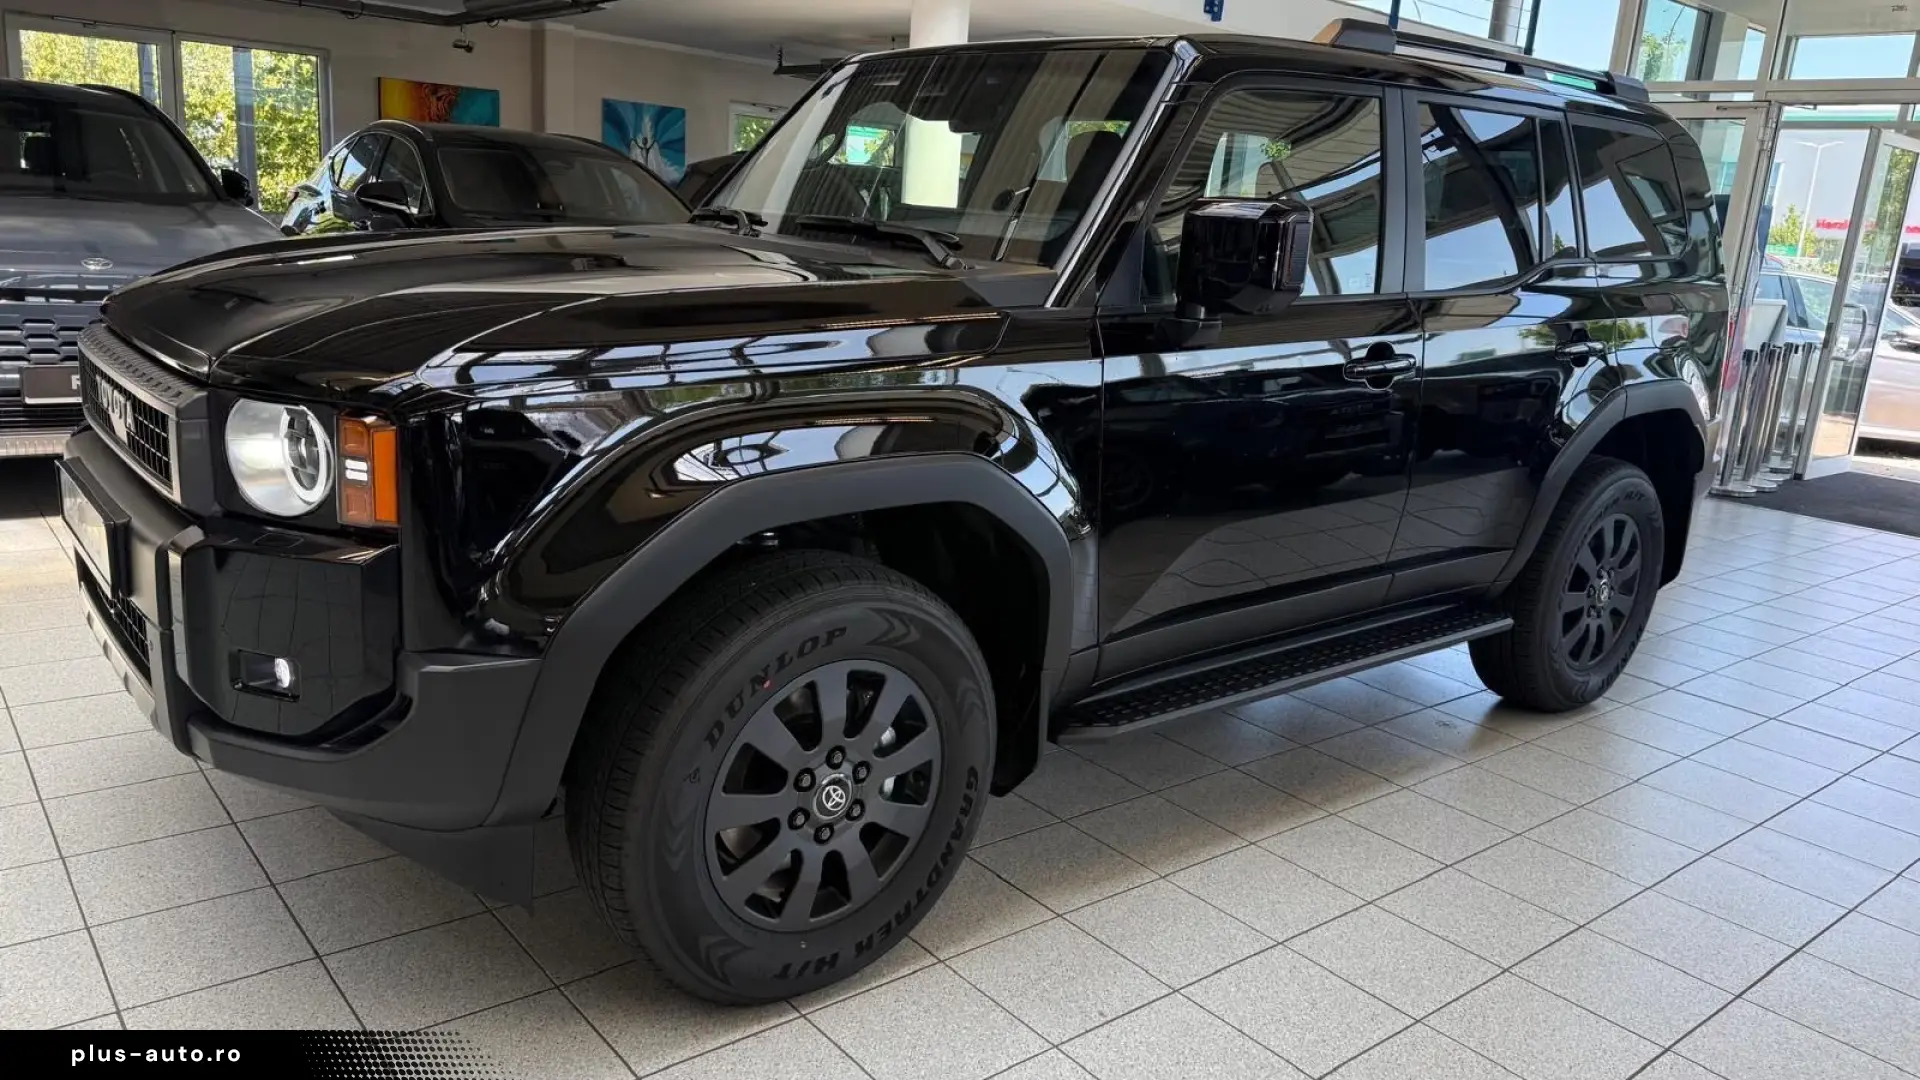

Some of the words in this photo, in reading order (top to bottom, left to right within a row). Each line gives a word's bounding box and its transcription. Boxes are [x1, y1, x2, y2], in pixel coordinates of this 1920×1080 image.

[96, 375, 136, 433] TOYOTA
[703, 625, 848, 752] DUNLOP
[854, 765, 979, 958] GRANDTREK
